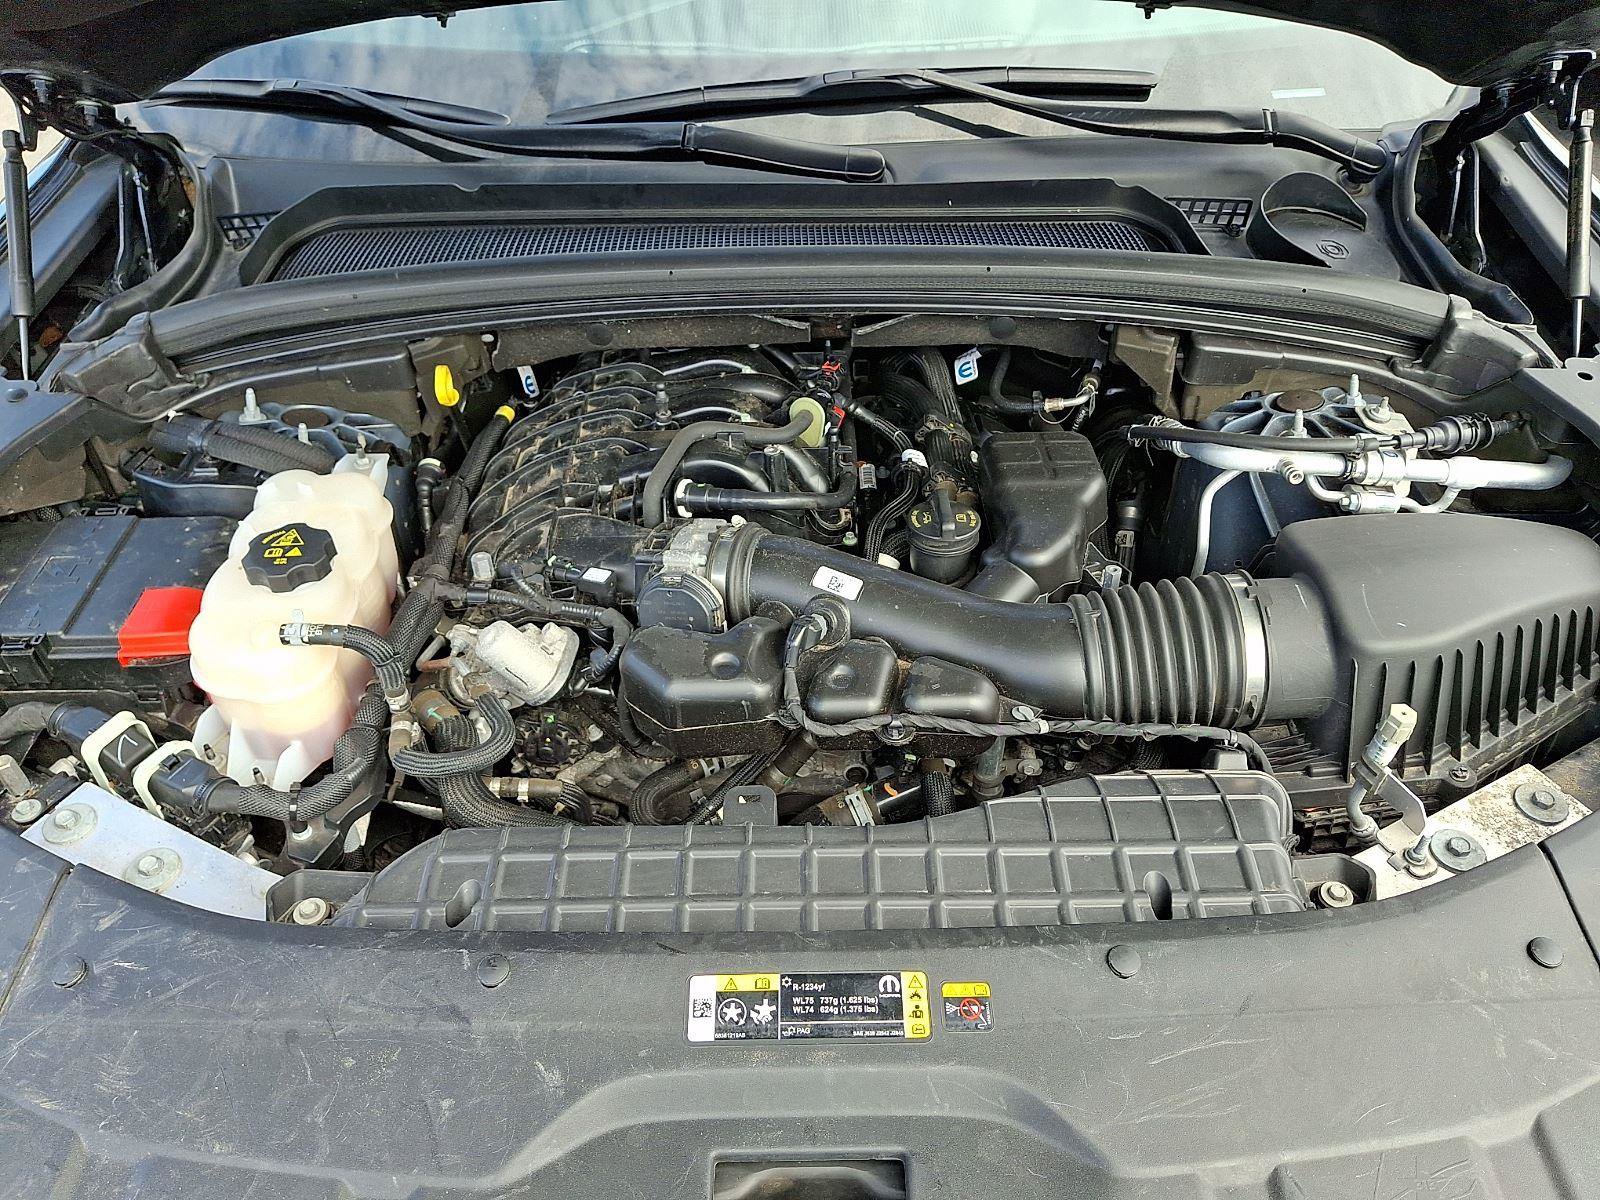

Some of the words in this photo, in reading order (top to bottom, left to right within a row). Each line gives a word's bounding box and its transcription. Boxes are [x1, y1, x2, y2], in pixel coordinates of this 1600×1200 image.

[792, 982, 826, 992] R-1234yf
[792, 997, 814, 1005] WL75
[819, 996, 839, 1006] 737g
[864, 995, 879, 1005] lbs)
[792, 1006, 814, 1014] WL74
[819, 1005, 839, 1014] 624g
[864, 1005, 879, 1014] lbs)
